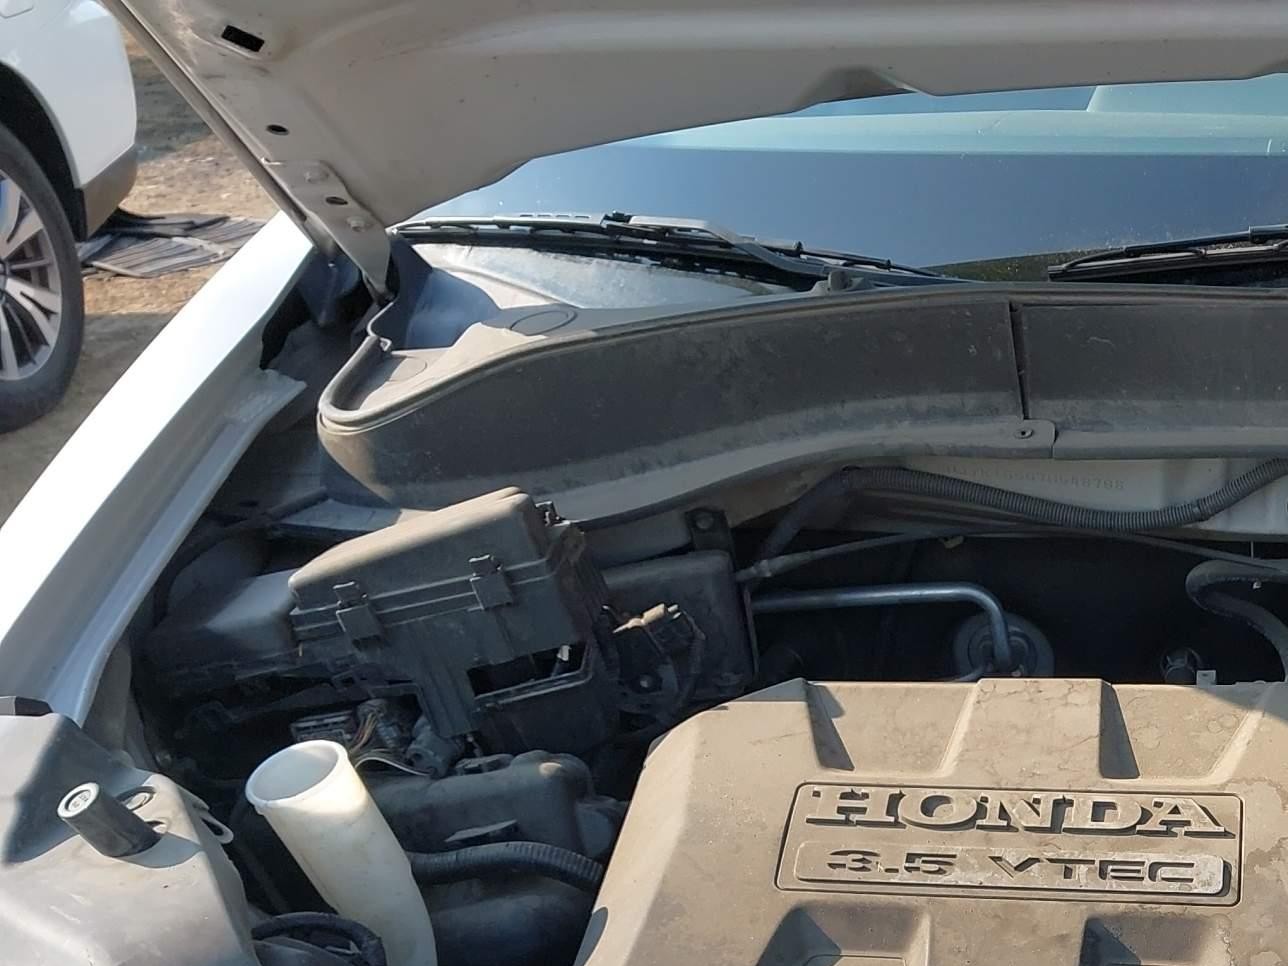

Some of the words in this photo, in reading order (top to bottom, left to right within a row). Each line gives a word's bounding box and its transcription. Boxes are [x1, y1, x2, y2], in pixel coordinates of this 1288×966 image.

[805, 786, 1235, 839] HONDA
[828, 849, 958, 876] 3.5
[988, 854, 1196, 884] VTEC
